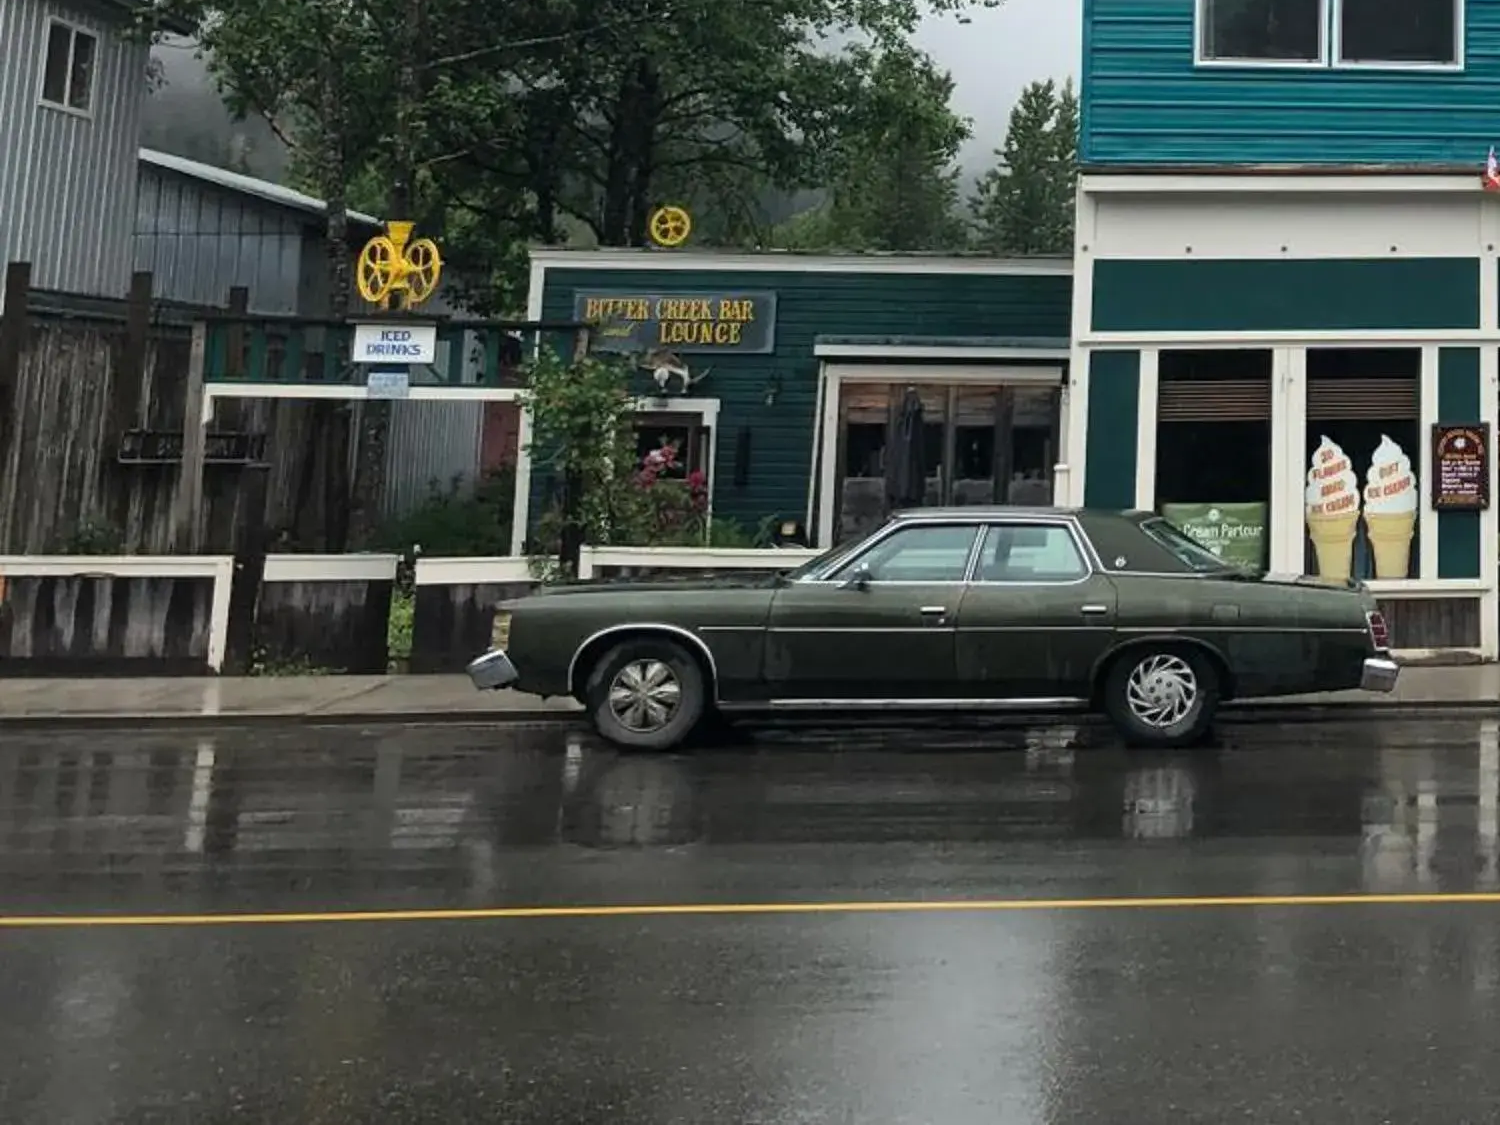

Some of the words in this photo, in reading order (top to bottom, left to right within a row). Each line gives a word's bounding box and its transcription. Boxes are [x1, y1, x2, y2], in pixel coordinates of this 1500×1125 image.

[655, 298, 713, 320] CREEK
[719, 298, 754, 321] BAR
[380, 330, 411, 342] ICED
[659, 321, 743, 345] LOUNGE
[366, 344, 421, 356] DRINKS
[1183, 522, 1219, 538] Cream
[1221, 522, 1263, 538] Parlour
